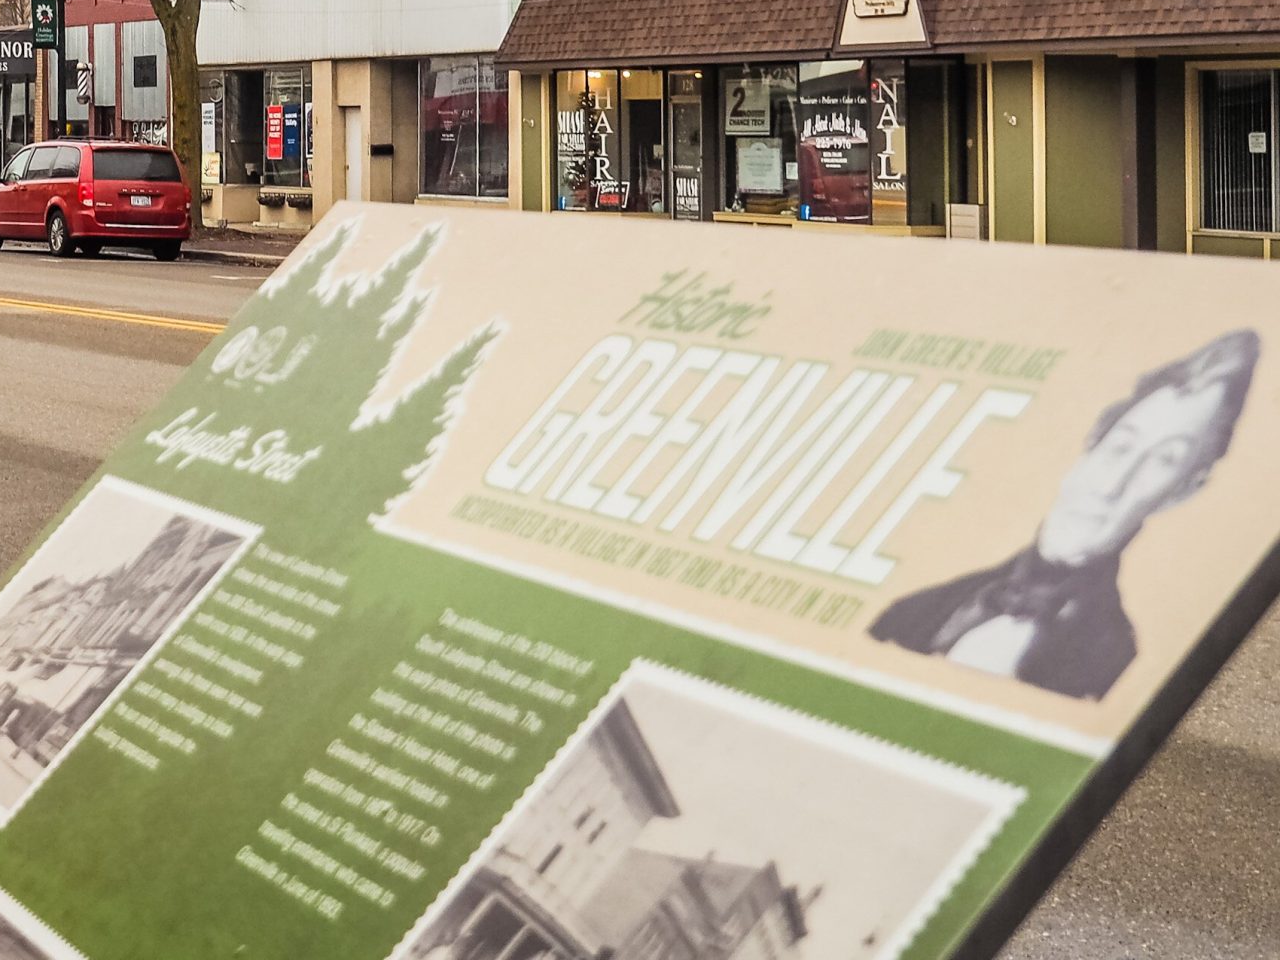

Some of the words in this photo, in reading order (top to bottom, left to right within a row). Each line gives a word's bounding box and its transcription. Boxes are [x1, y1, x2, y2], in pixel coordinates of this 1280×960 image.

[593, 87, 614, 180] HAIR
[874, 78, 901, 180] NAIL
[872, 181, 906, 191] SALON
[617, 267, 773, 339] Historic
[975, 343, 1069, 382] VILLAGE
[145, 406, 252, 470] Lafayette
[233, 428, 324, 484] Street
[483, 334, 1034, 586] GREENVILLE
[569, 525, 638, 564] VILLAGE
[678, 556, 723, 589] AND
[750, 575, 803, 609] CITY
[790, 587, 825, 619] IN
